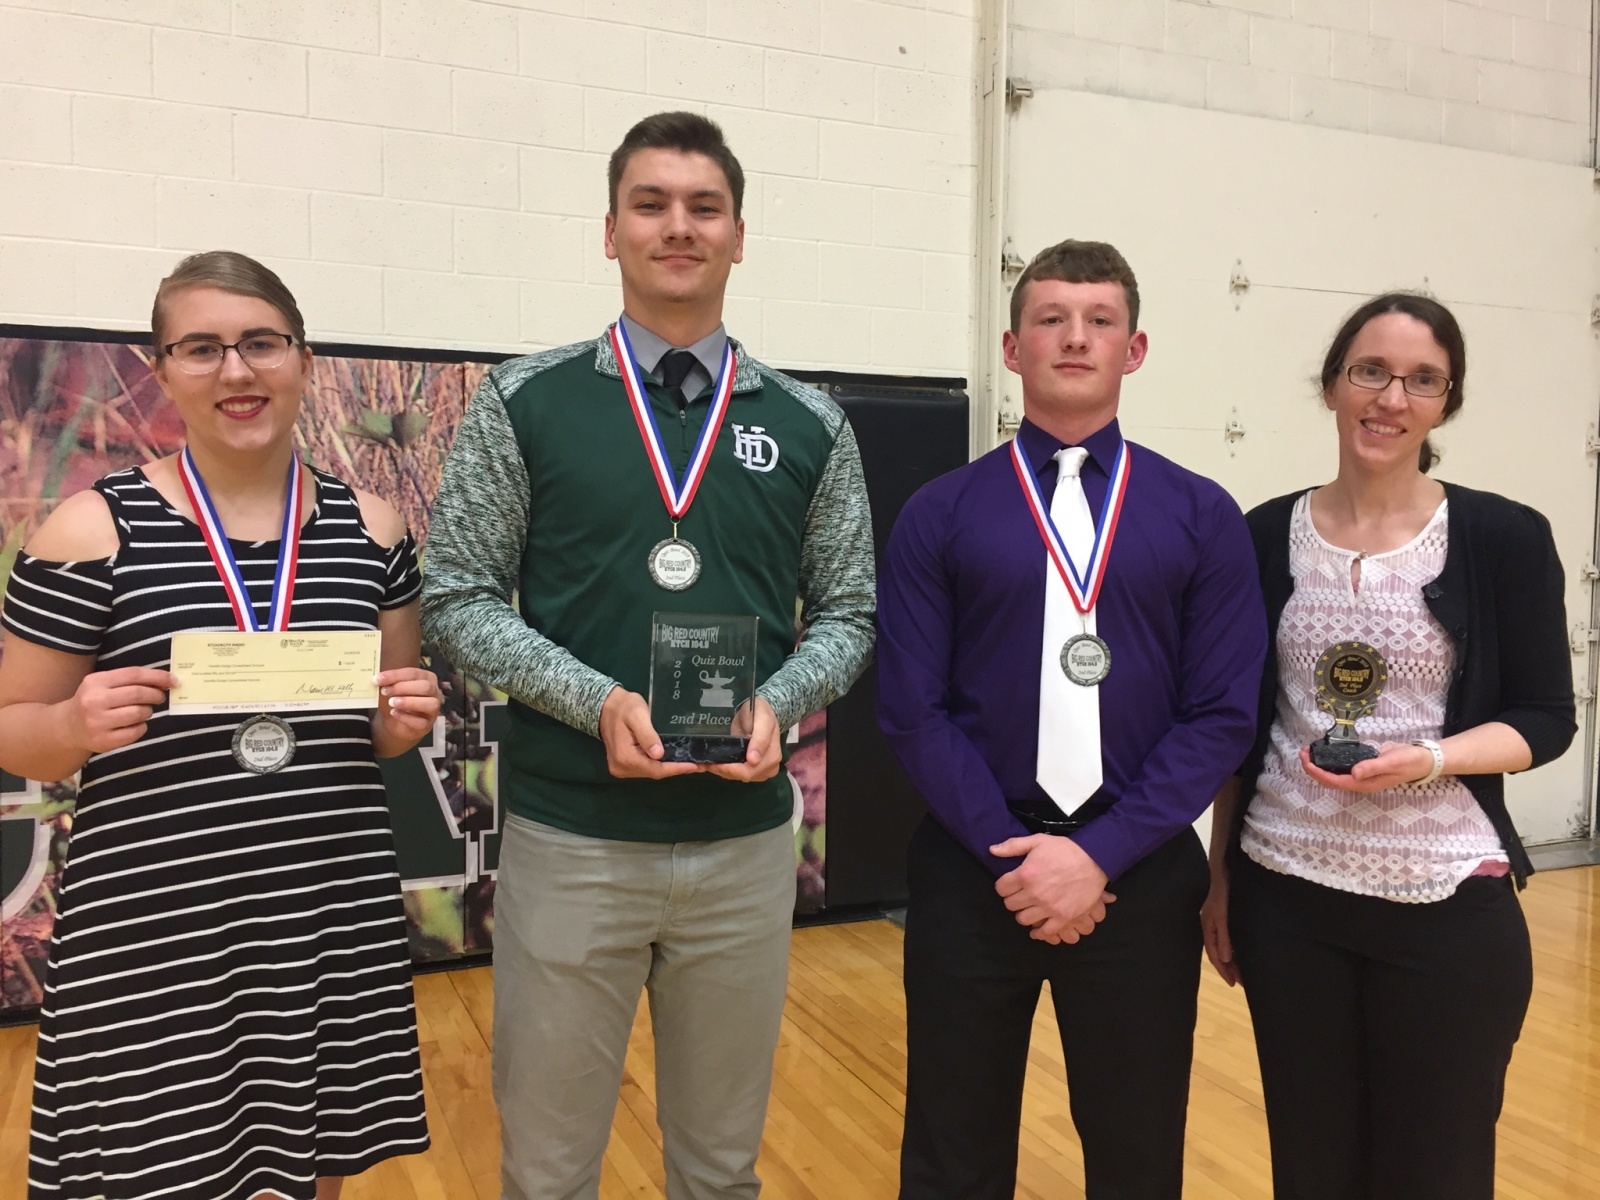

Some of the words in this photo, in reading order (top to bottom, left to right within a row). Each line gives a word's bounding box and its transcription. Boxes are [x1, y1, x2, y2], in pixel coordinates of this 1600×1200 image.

[675, 558, 692, 569] COUNTRY
[661, 623, 673, 642] BIG
[674, 626, 688, 640] RED
[689, 625, 720, 644] COUNTRY
[670, 639, 690, 648] KTCH
[691, 655, 716, 667] Quiz
[717, 656, 745, 667] Bowl
[670, 712, 696, 725] 2nd
[697, 713, 731, 725] Place
[245, 738, 253, 750] BIG
[253, 739, 263, 747] RED
[263, 736, 284, 748] COUNTRY
